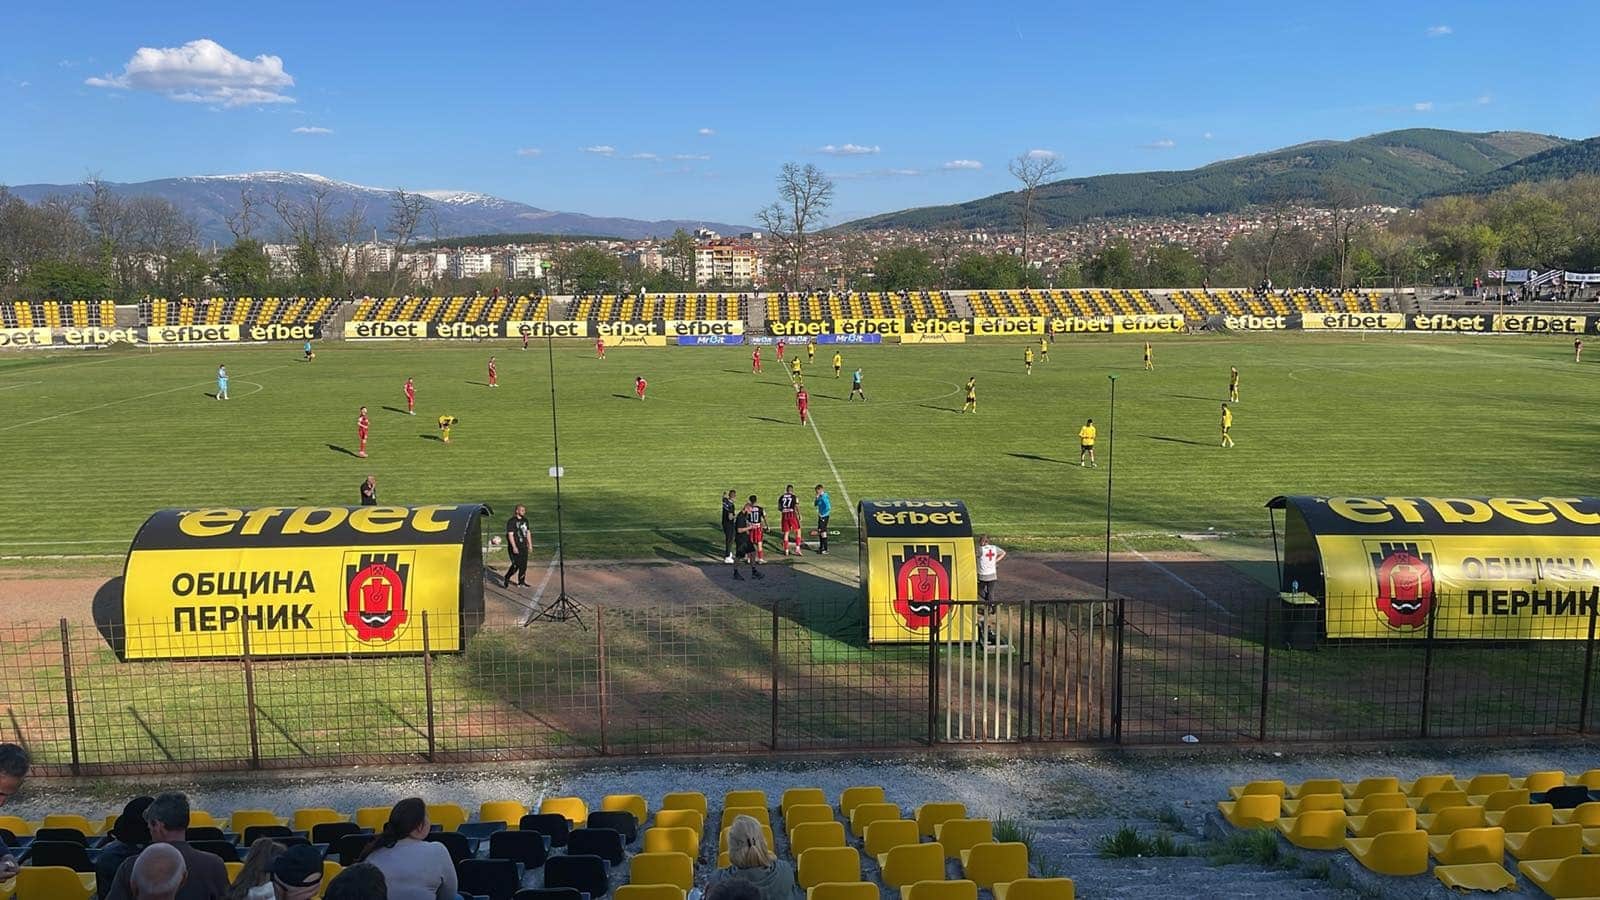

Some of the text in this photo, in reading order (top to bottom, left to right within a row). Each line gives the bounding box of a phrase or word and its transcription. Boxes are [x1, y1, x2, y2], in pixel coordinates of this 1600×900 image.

[597, 320, 657, 336] efbet
[674, 320, 733, 335] efbet
[770, 320, 830, 335] efbet
[840, 319, 899, 334] efbet
[911, 318, 971, 333] efbet
[980, 317, 1037, 332] efbet
[1052, 316, 1110, 332] efbet
[1121, 314, 1180, 330] efbet
[1226, 314, 1287, 330] efbet
[1322, 313, 1388, 328] efbet
[1413, 313, 1486, 331] efbet
[1502, 314, 1576, 331] efbet
[64, 326, 138, 344] efbet
[160, 325, 230, 341] efbet
[249, 323, 314, 340] efbet
[355, 321, 418, 337] efbet
[436, 322, 499, 337] efbet
[517, 321, 578, 337] efbet
[873, 511, 963, 525] efbet
[1326, 497, 1600, 525] efbet
[179, 505, 457, 537] efbet
[171, 570, 316, 599] ОБЩИНА
[1467, 589, 1600, 616] ПЕРНИК
[174, 604, 314, 633] ПЕРНИК
